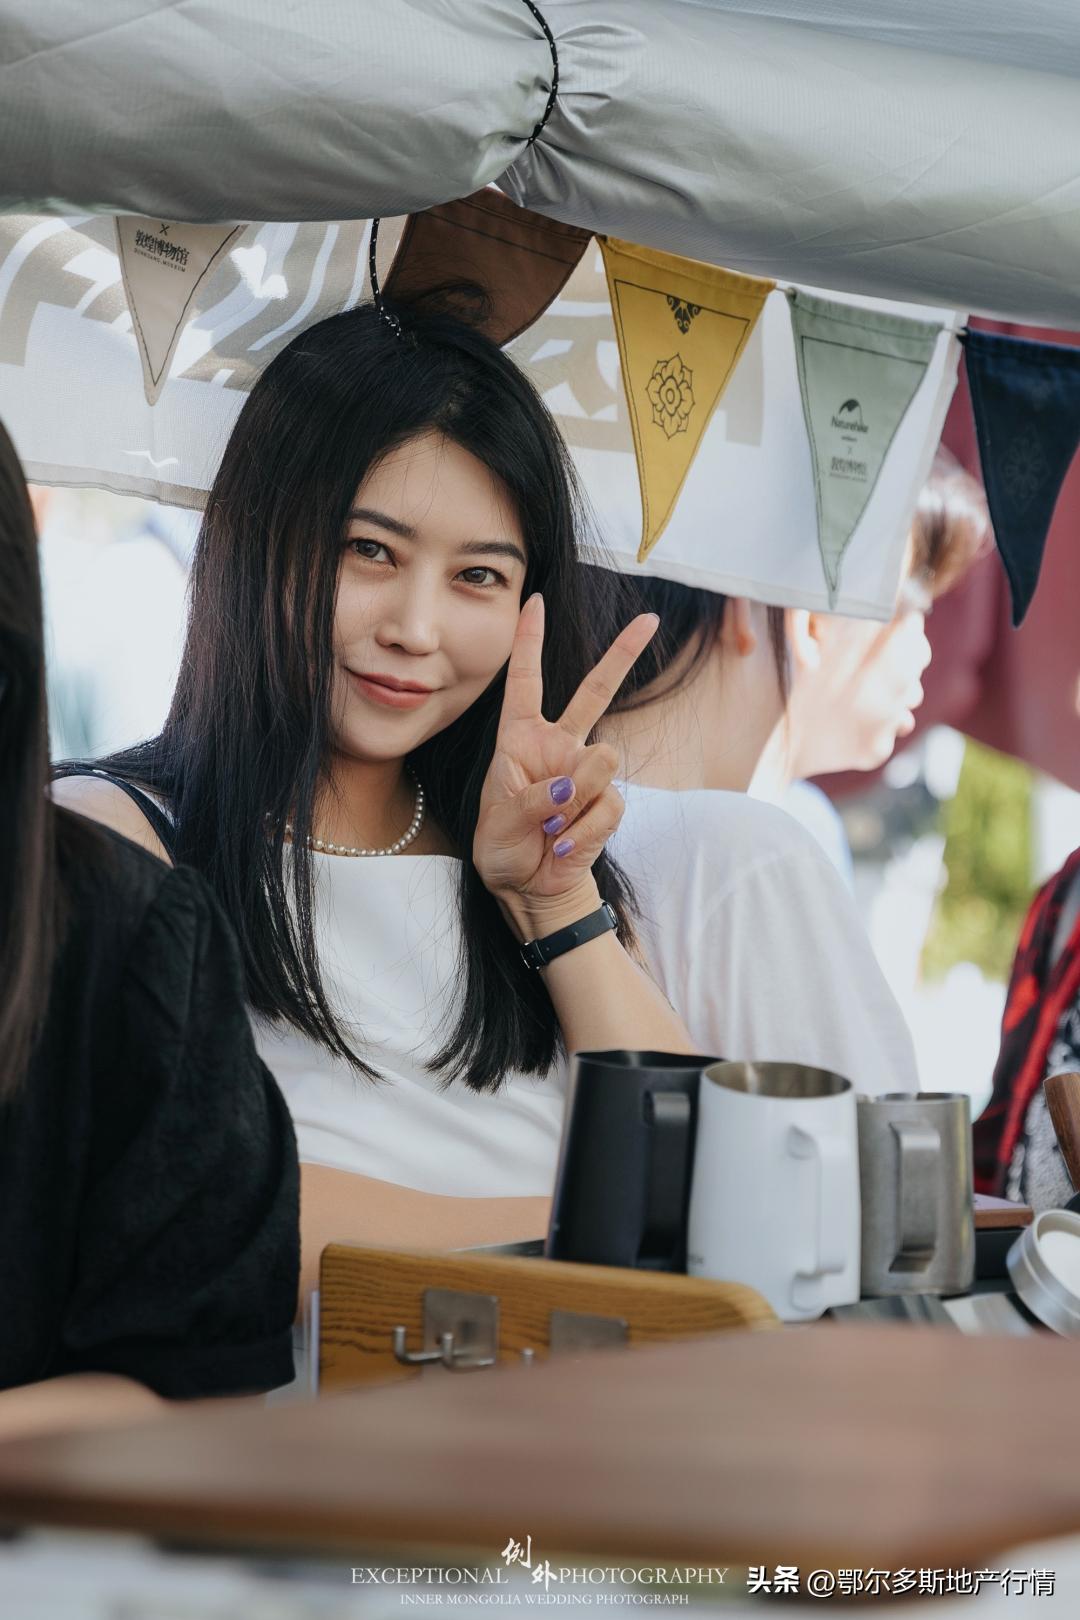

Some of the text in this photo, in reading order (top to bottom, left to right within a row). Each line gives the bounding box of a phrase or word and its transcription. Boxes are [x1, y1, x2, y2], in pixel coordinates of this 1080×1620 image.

[135, 228, 190, 266] 敦煌博物馆
